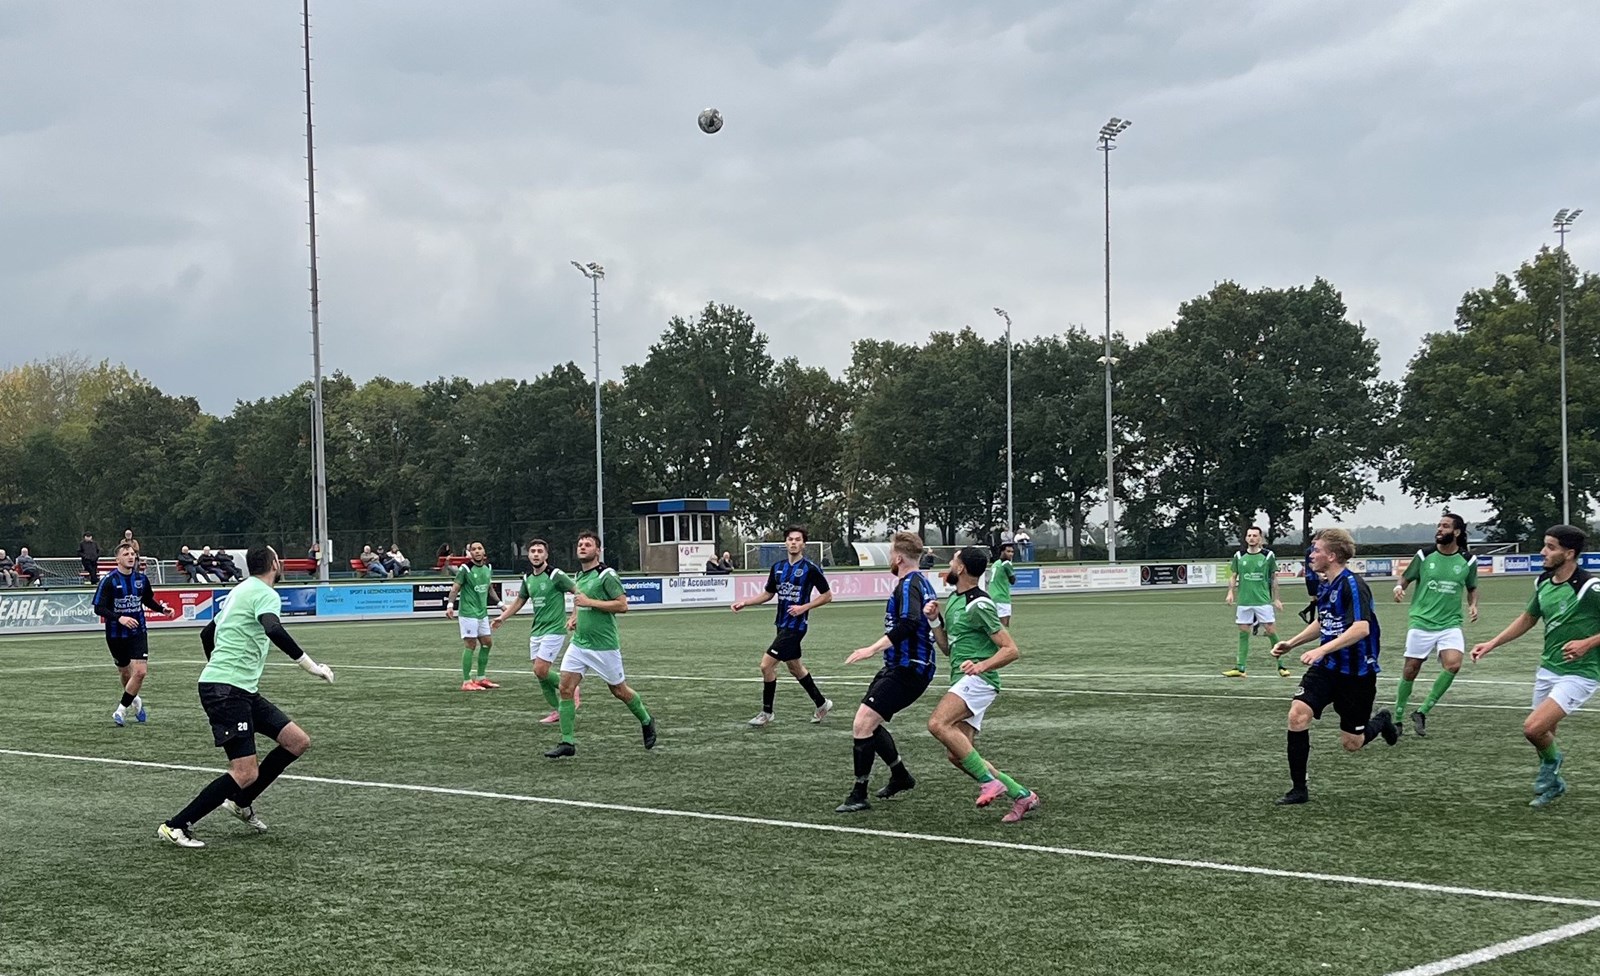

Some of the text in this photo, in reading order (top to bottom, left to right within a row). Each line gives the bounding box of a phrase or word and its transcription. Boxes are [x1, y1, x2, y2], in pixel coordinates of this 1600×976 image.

[688, 577, 728, 588] Accountancy
[743, 581, 768, 597] IN
[0, 599, 49, 620] EARLE
[237, 721, 248, 731] 20
